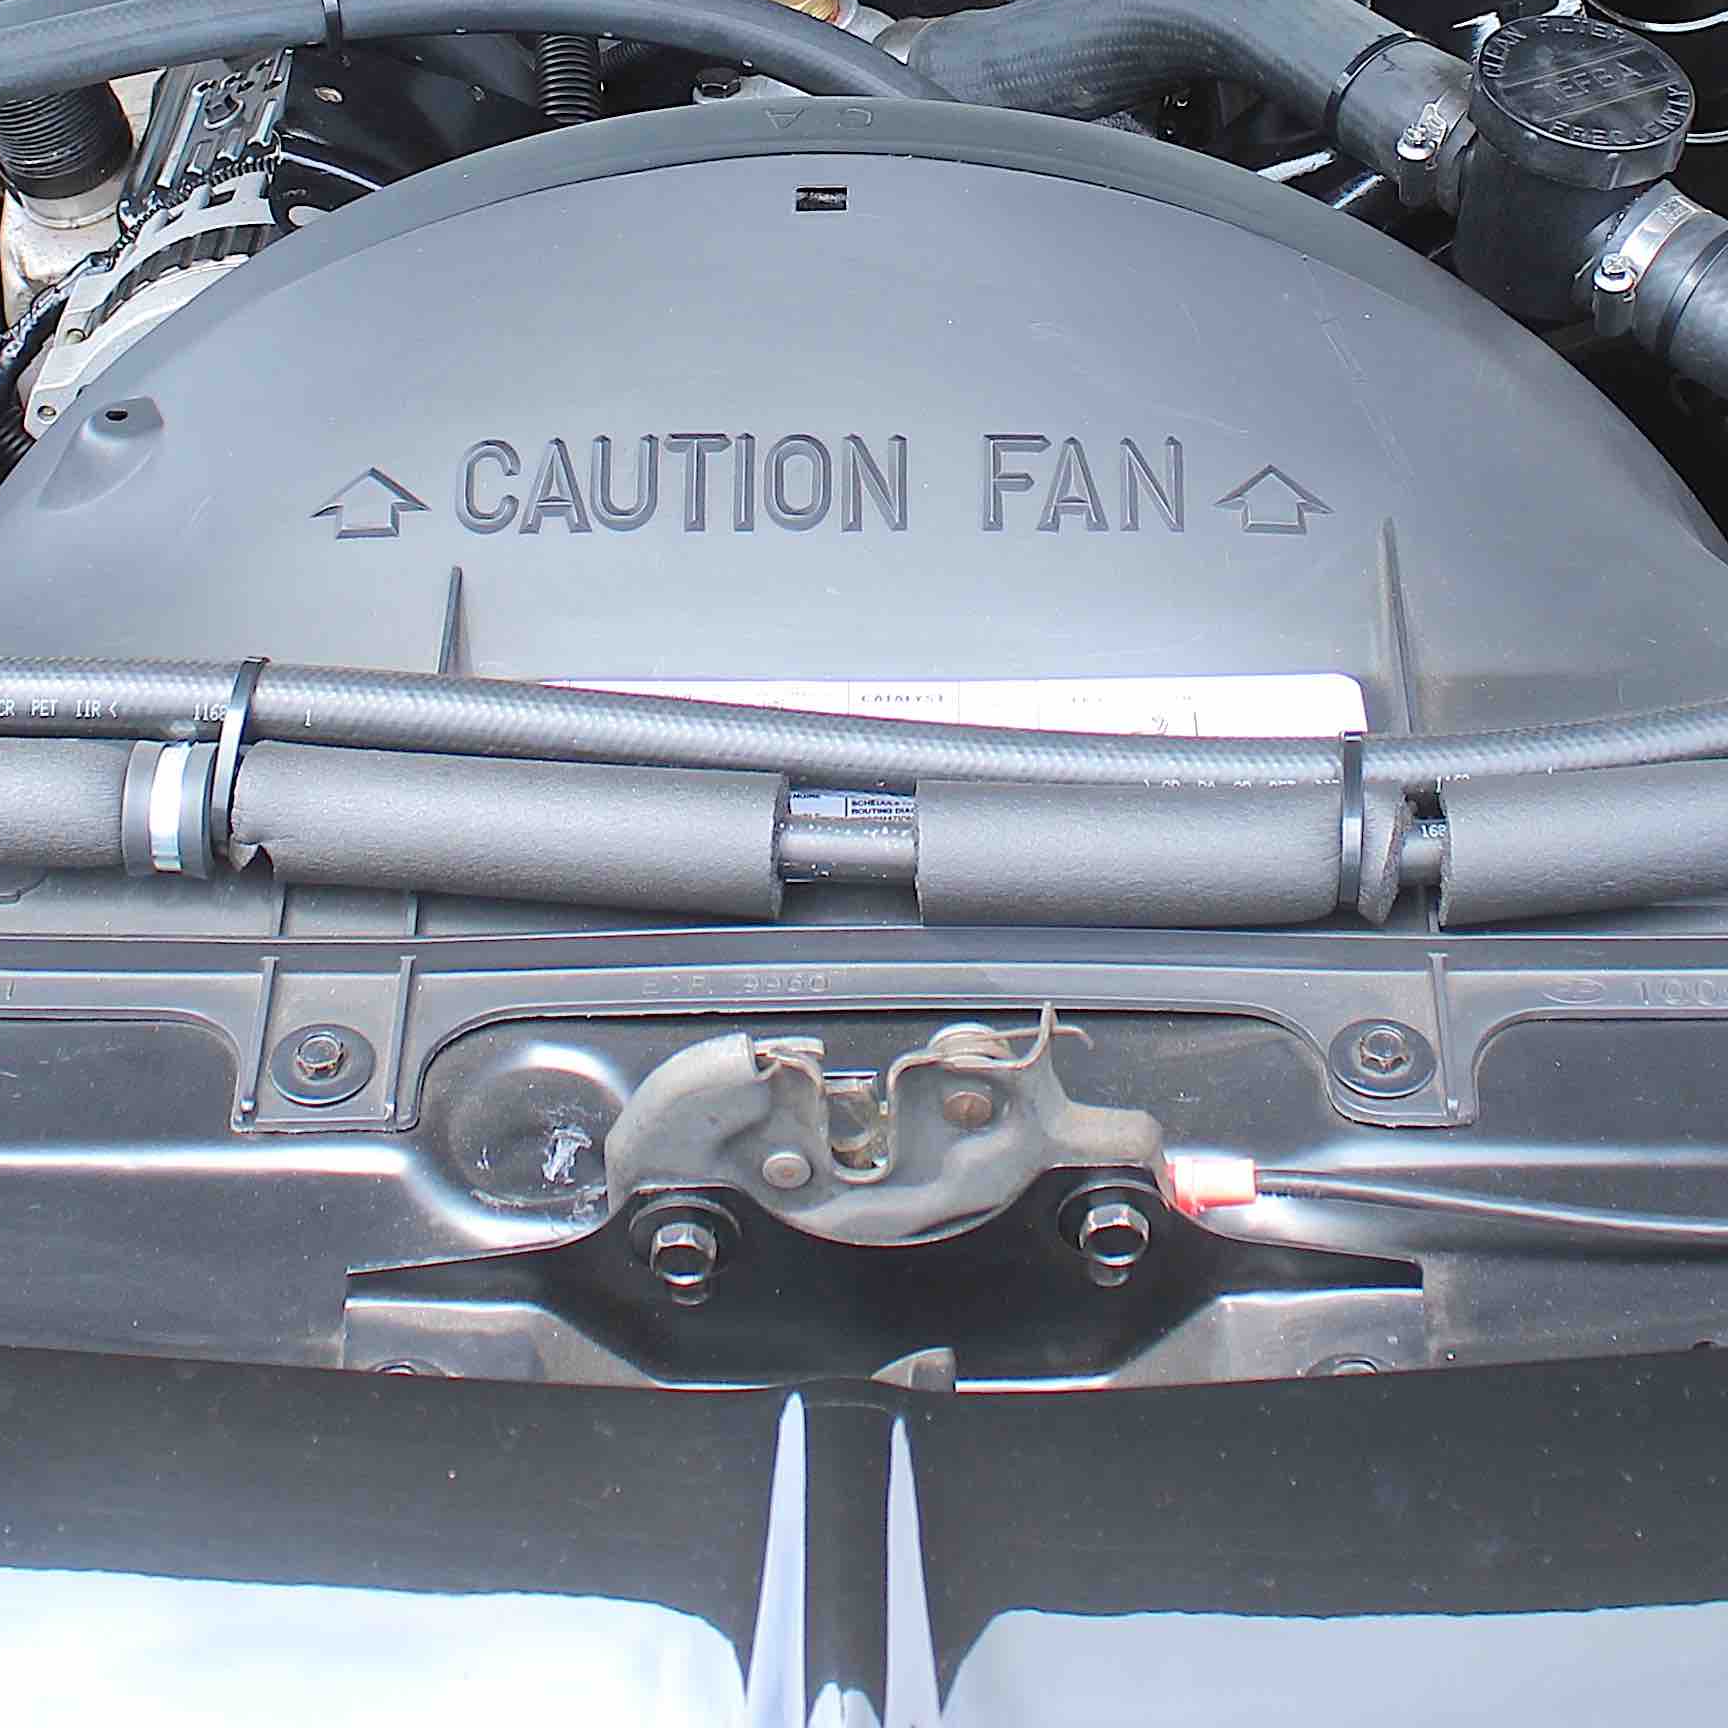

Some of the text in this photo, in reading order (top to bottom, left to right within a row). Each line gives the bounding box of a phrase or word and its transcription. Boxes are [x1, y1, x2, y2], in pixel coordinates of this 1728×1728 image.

[1483, 25, 1528, 78] CLEAN
[456, 433, 1185, 534] CAUTION FAN
[31, 700, 58, 718] PET
